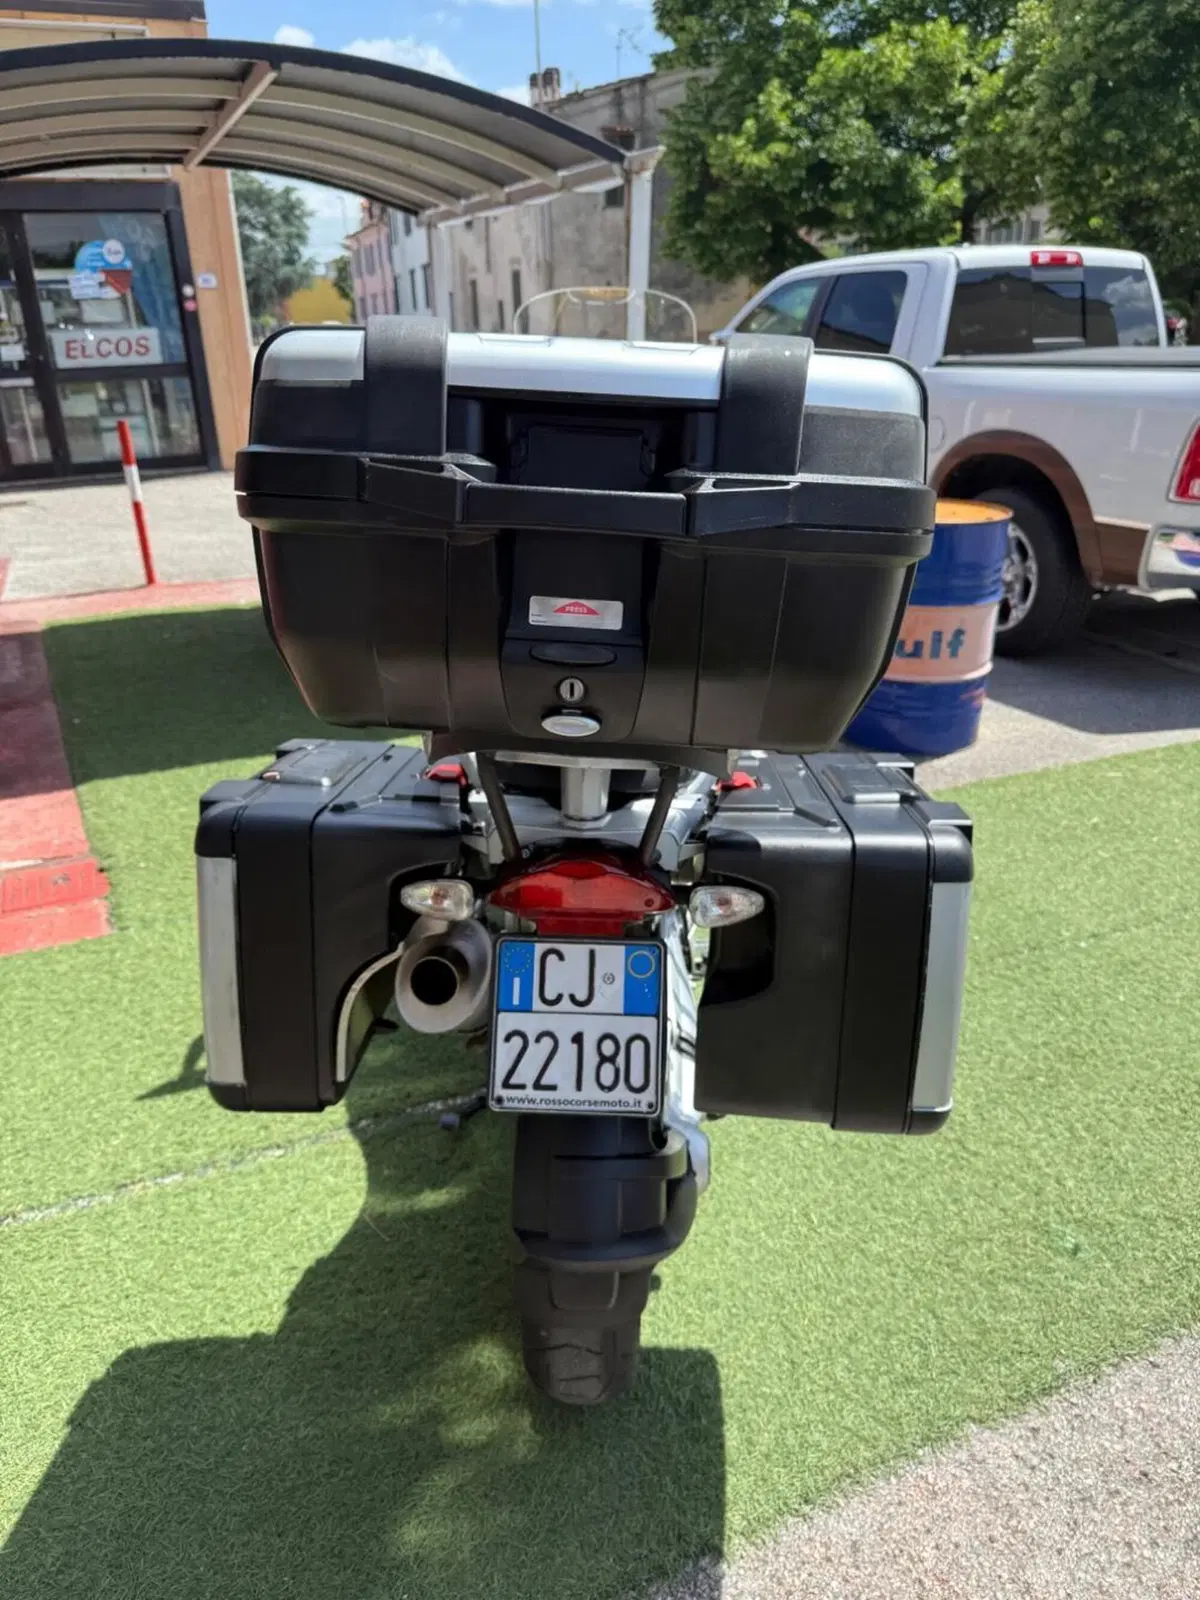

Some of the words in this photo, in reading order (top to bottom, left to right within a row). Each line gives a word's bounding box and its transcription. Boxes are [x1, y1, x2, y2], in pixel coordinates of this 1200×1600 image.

[64, 336, 151, 360] ELCOS
[564, 605, 588, 614] PRESS
[894, 628, 966, 659] ulf
[538, 947, 596, 1007] CJ
[501, 1029, 651, 1094] 22180
[505, 1094, 642, 1109] www.rossocorsemoto.it
